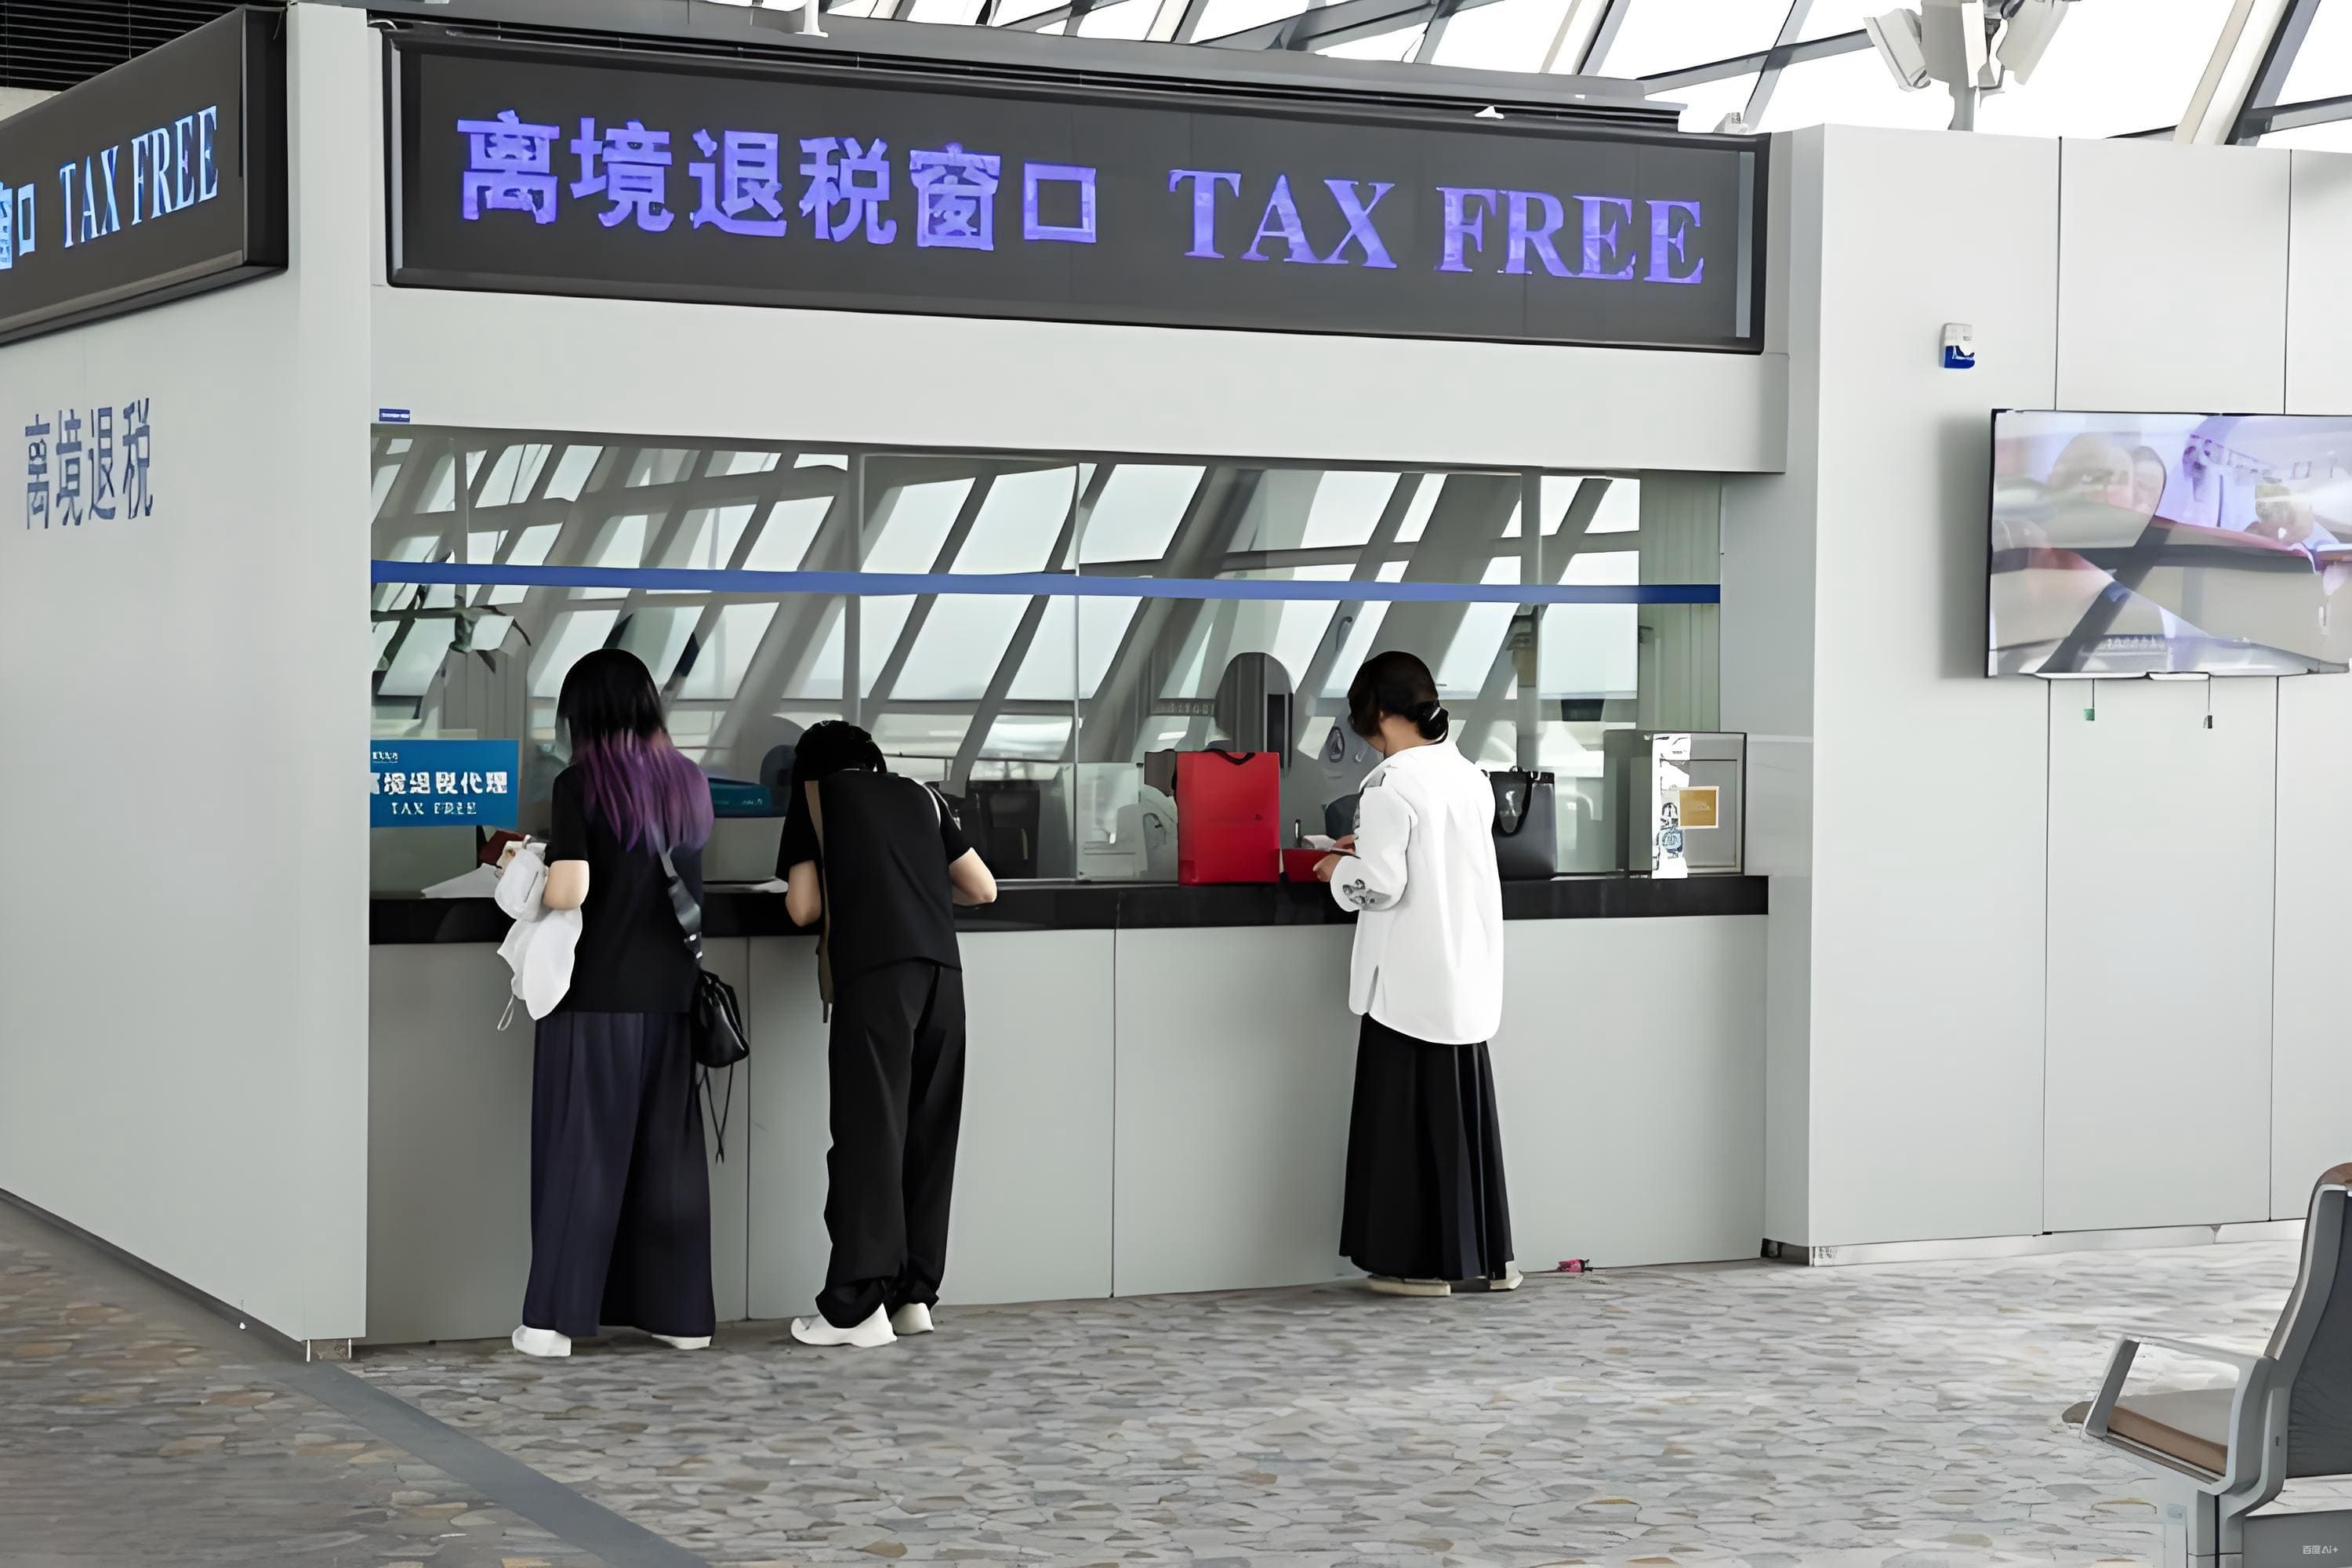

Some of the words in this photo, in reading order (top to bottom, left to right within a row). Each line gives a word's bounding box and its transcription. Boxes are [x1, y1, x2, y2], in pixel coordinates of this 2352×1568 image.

[59, 146, 121, 249] TAX
[132, 106, 218, 225] FREE
[457, 109, 1098, 252] 离境退税窗口
[1168, 169, 1398, 270] TAX
[1434, 185, 1704, 285] FREE
[25, 397, 154, 530] 离境退税
[391, 802, 424, 815] TAX
